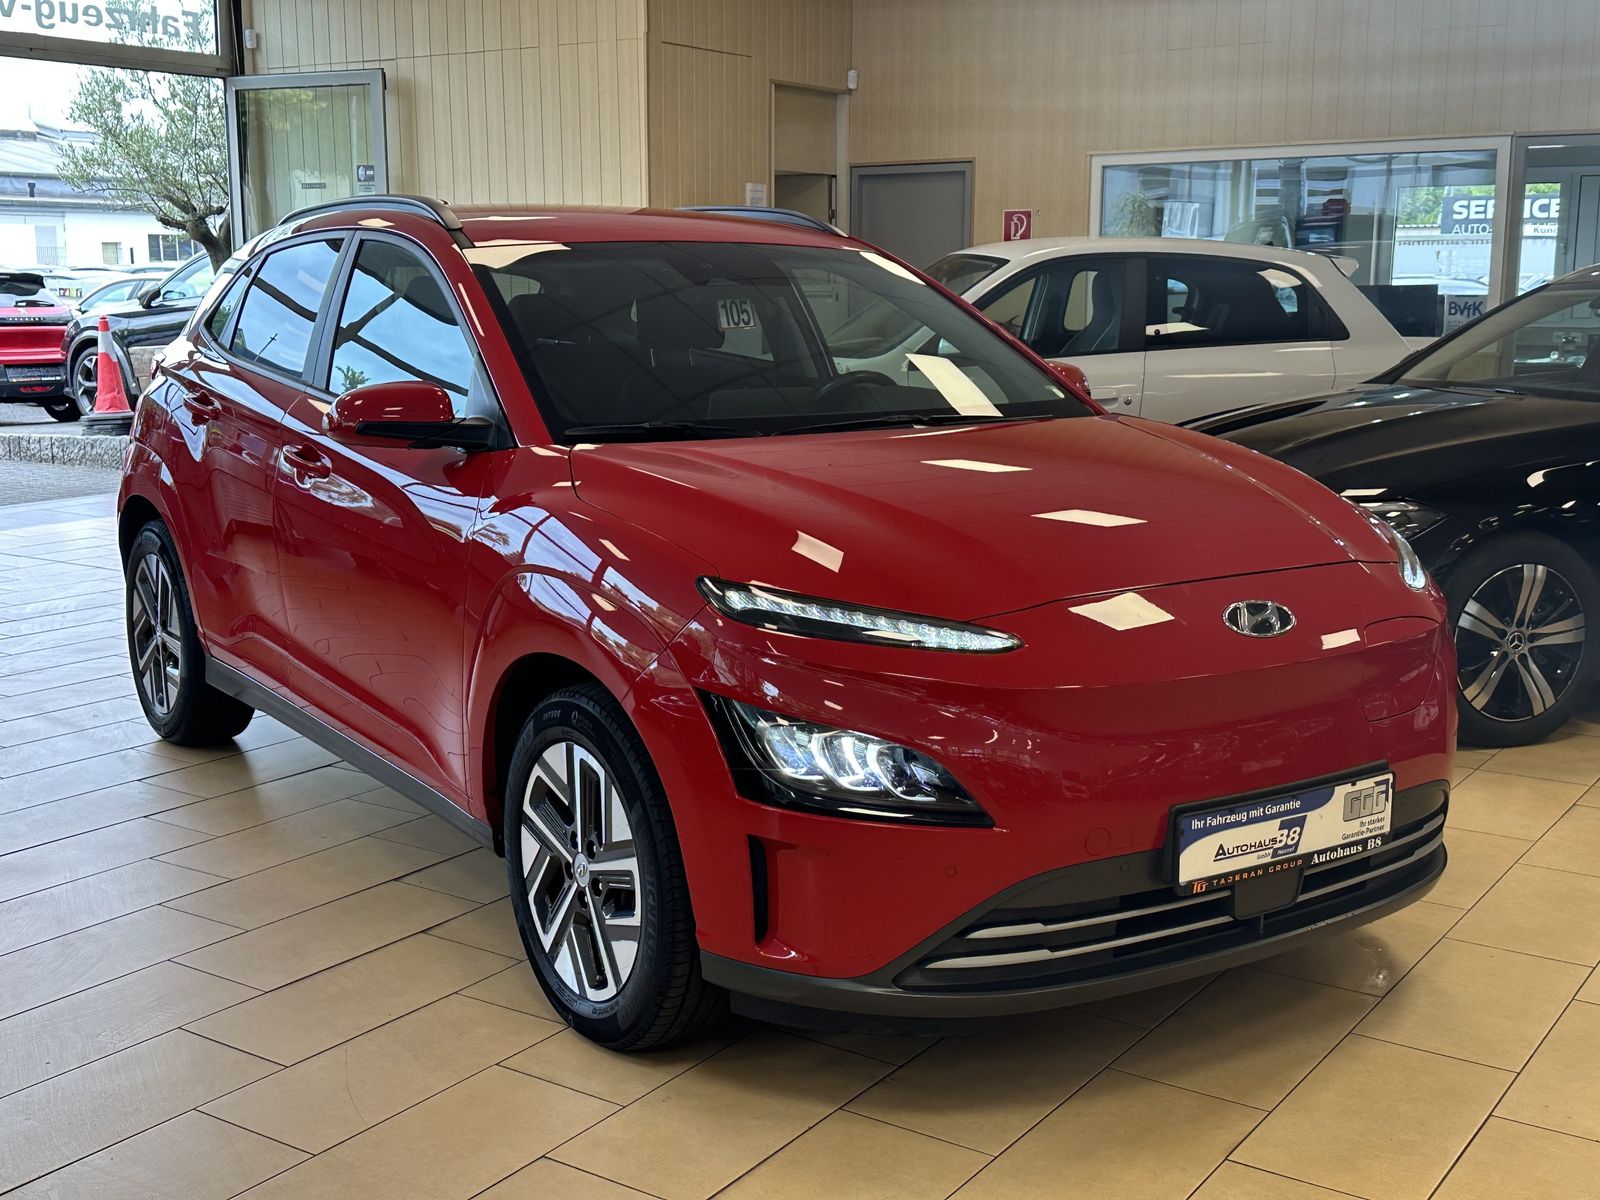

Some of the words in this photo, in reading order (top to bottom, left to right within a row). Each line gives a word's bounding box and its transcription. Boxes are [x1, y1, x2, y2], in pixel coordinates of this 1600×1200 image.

[720, 300, 751, 327] 105
[1191, 819, 1205, 830] Ihr
[1206, 811, 1247, 827] Fahrzeug
[1249, 806, 1264, 818] mit
[1265, 799, 1301, 814] Garantie
[1311, 844, 1363, 864] Autohaus
[1367, 836, 1382, 850] B8
[1268, 859, 1303, 873] GROUP
